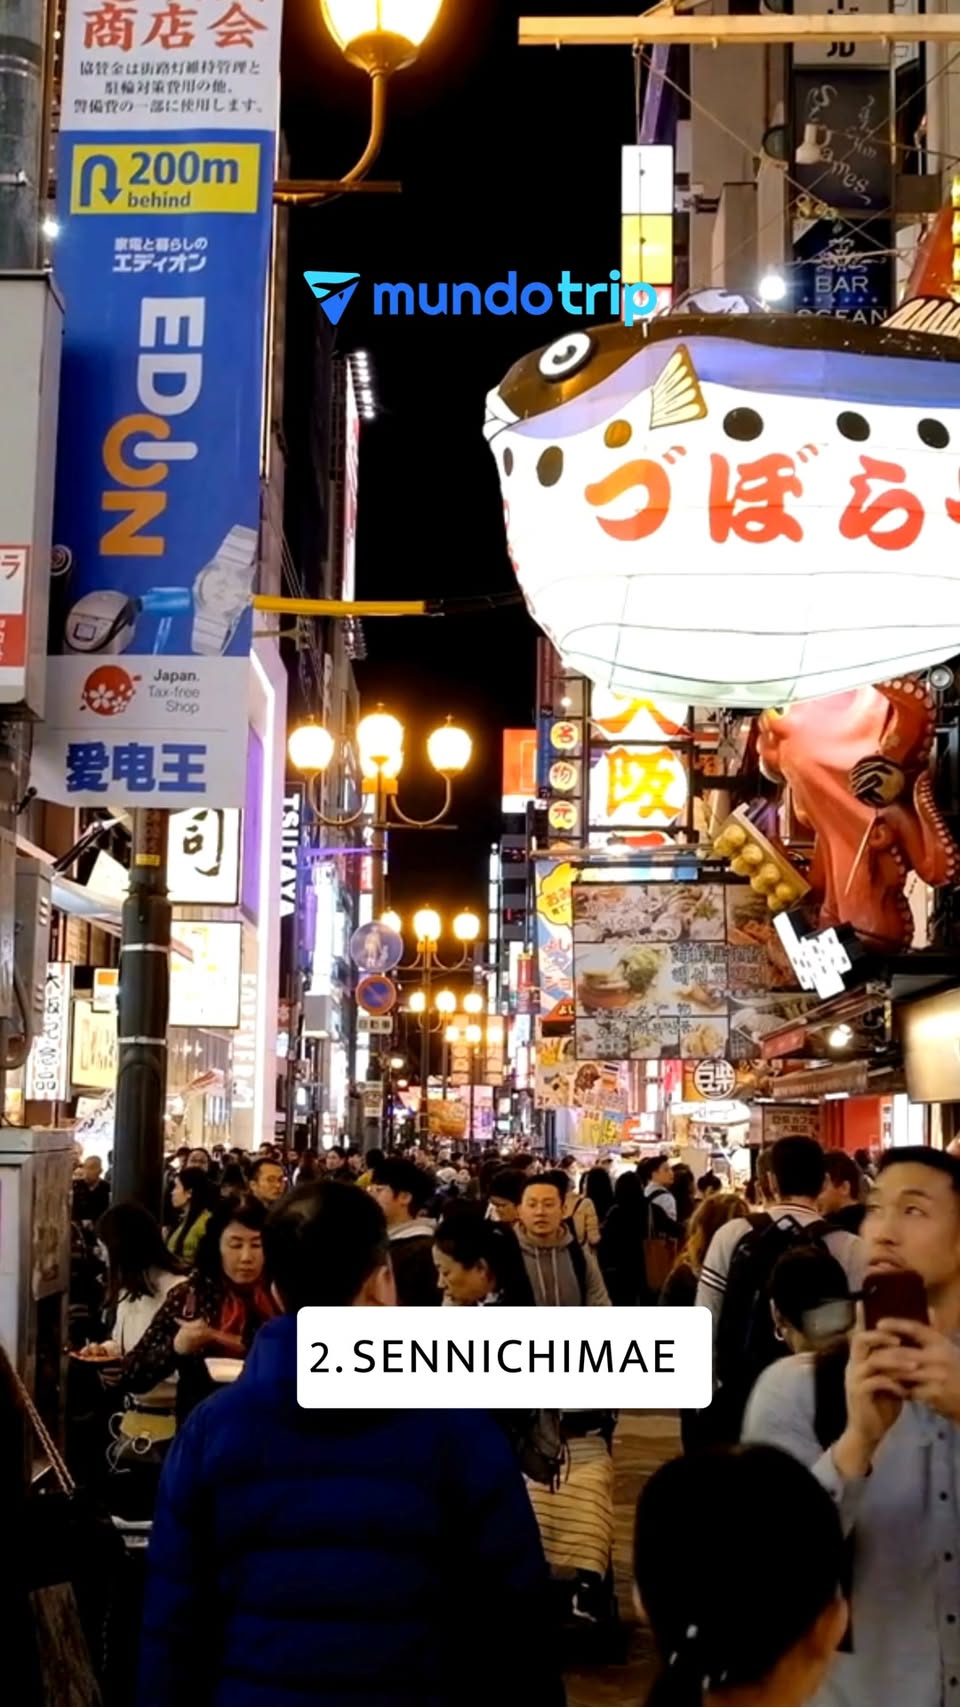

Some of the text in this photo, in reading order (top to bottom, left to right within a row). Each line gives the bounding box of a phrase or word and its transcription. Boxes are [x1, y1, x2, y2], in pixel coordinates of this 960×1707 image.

[83, 3, 268, 51] 商店会
[129, 151, 239, 185] 200m
[128, 191, 191, 208] behind
[114, 237, 208, 250] 家電と暮らしの
[113, 254, 207, 272] エディオン
[815, 276, 868, 294] BAR
[98, 297, 206, 557] EDION
[584, 443, 960, 551] づぼら
[149, 686, 200, 698] Tax-free
[166, 700, 200, 714] Shop
[280, 793, 300, 918] TSUTAYA
